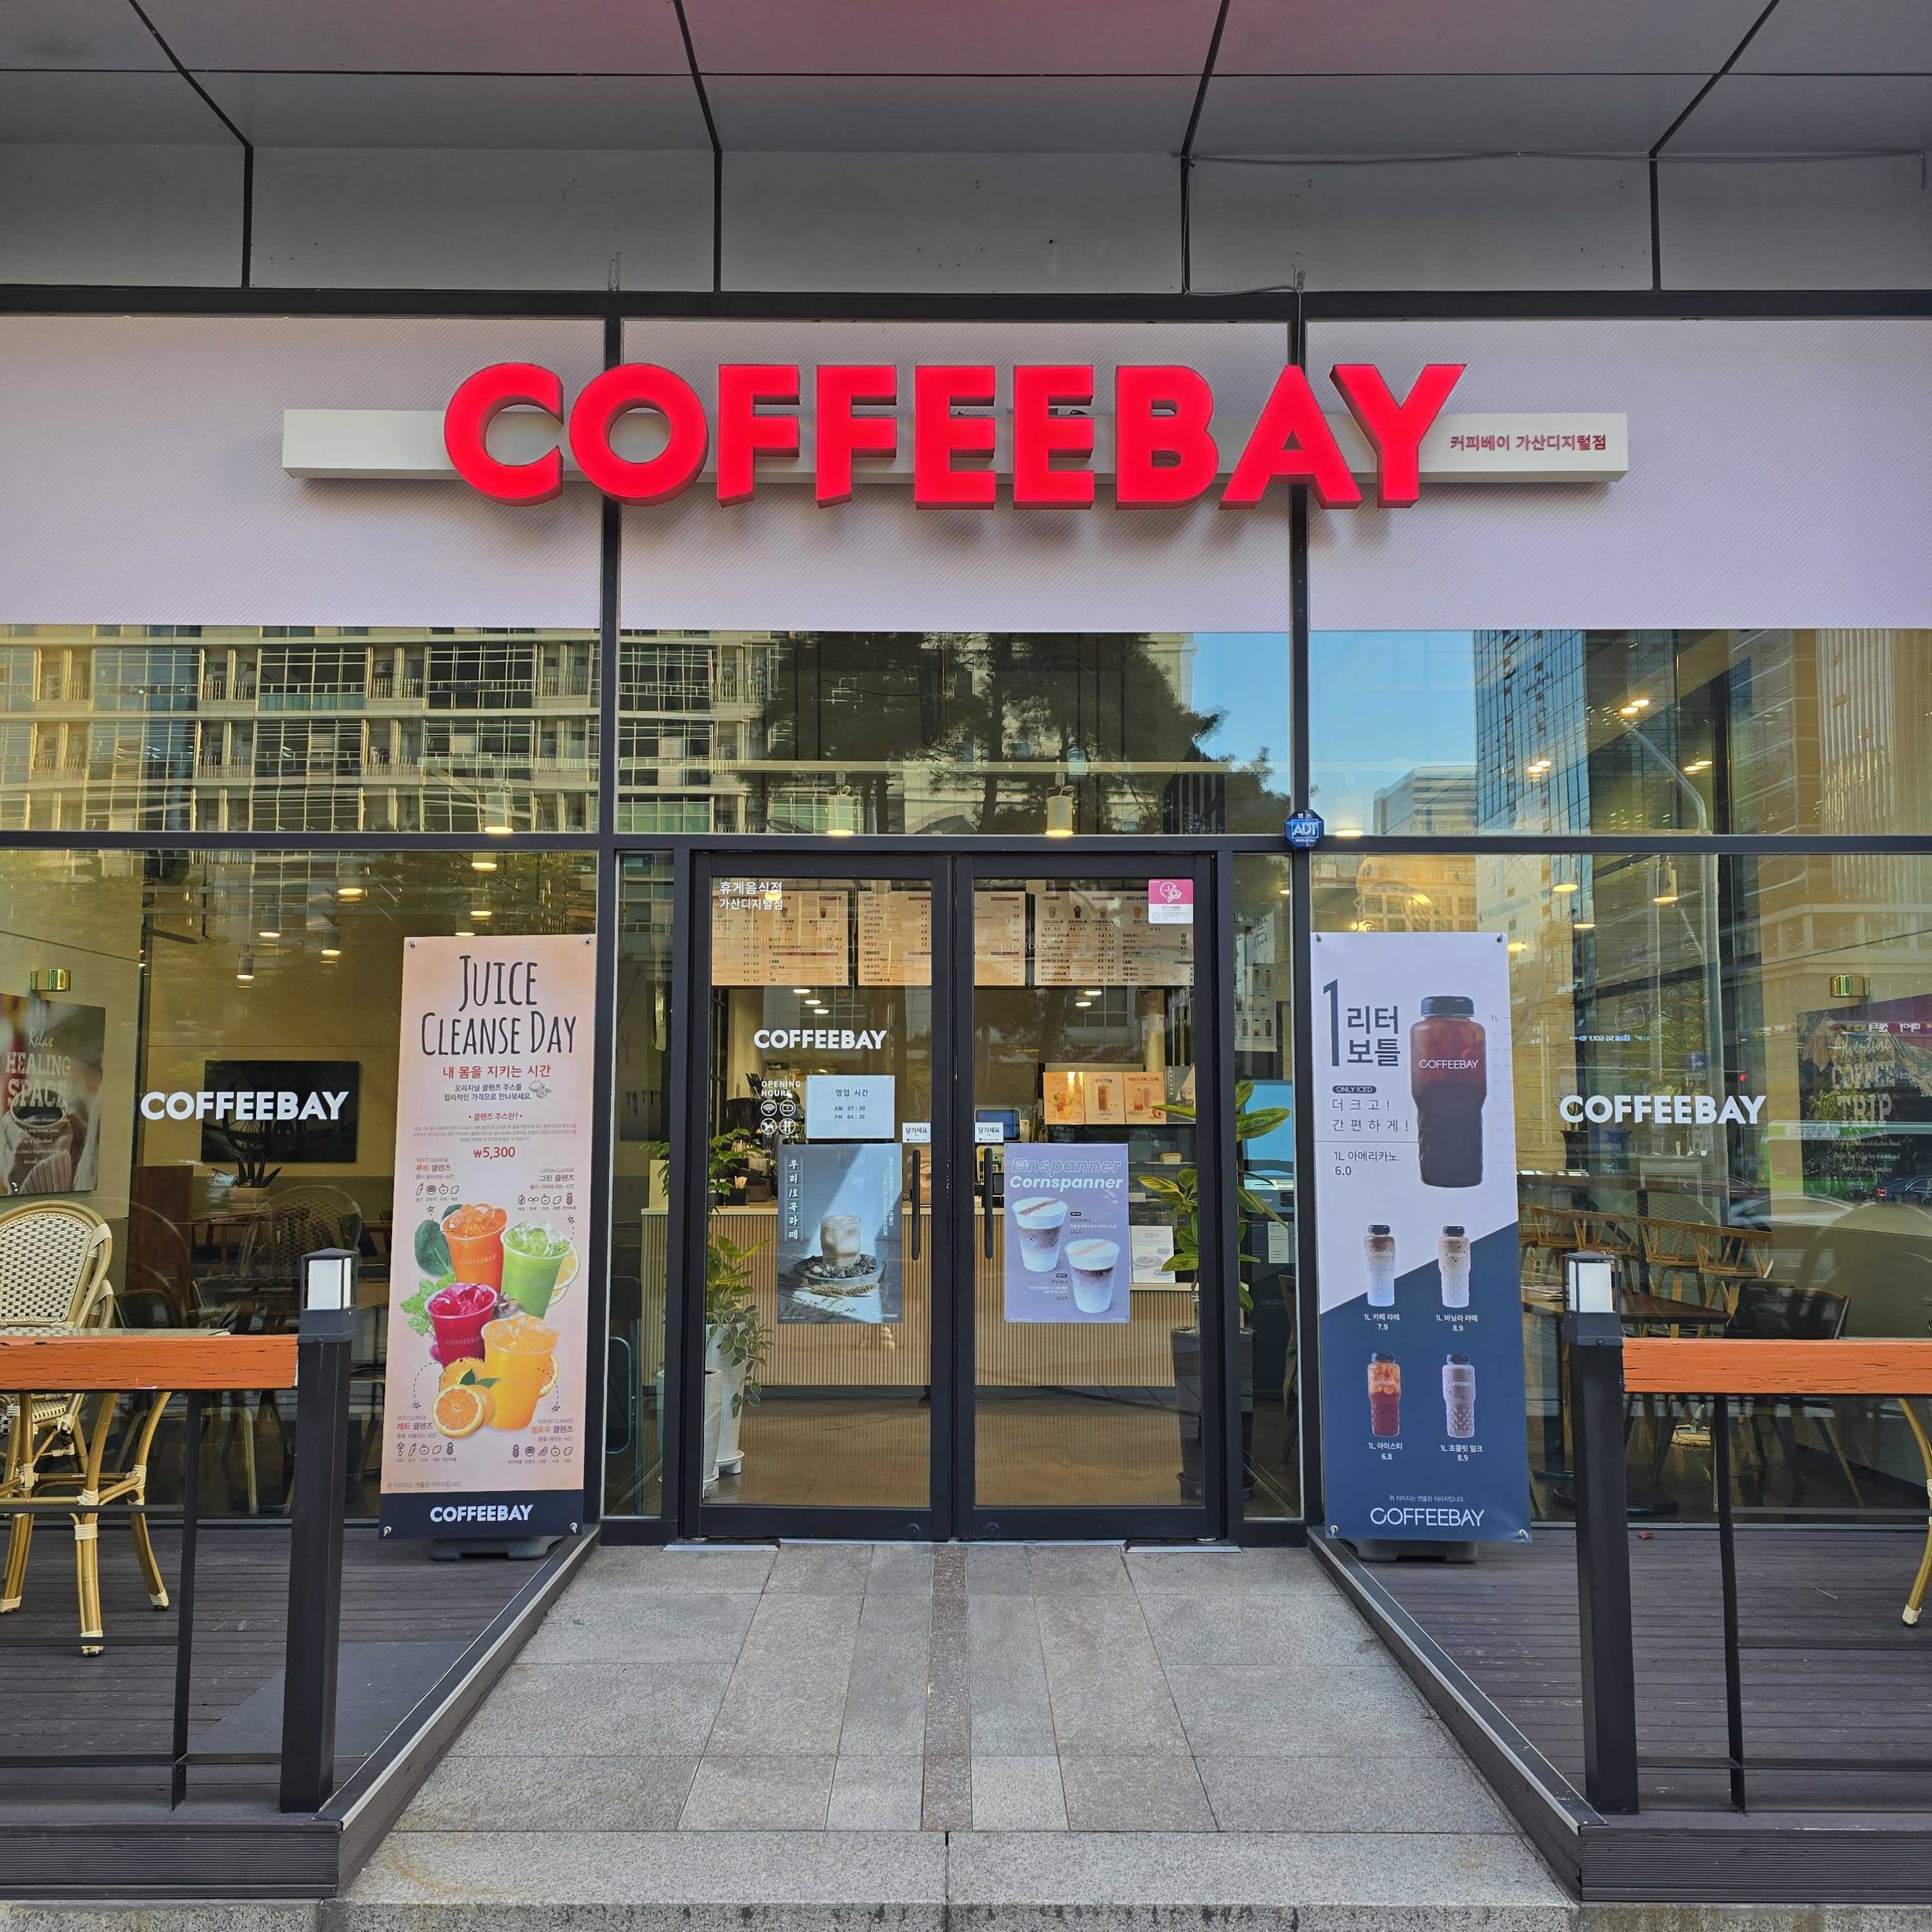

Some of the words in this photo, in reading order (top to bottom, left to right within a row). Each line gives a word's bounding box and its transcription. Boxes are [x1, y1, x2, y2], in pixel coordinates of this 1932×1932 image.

[444, 362, 1467, 509] COFFEEBAY
[1451, 435, 1510, 451] 커피베이
[1516, 435, 1606, 451] 가산디지털점
[1292, 822, 1317, 835] ADT
[458, 955, 538, 1012] JUICE
[1323, 979, 1339, 1066] 1
[1347, 1005, 1398, 1034] 리터
[422, 1012, 521, 1055] CLEANSE
[530, 1011, 577, 1053] DAY
[754, 1030, 887, 1049] COFFEEBAY
[1347, 1038, 1401, 1067] 보틀
[6, 1051, 71, 1076] HEALING
[443, 1067, 454, 1079] 내
[458, 1066, 482, 1078] 몸을
[487, 1065, 522, 1078] 지키는
[527, 1065, 551, 1078] 시간
[1419, 1059, 1479, 1069] COFFEEBAY
[7, 1078, 68, 1107] SPACE
[140, 1091, 349, 1120] COFFEEBAY
[1559, 1095, 1767, 1124] COFFEEBAY
[1837, 1093, 1893, 1127] TRIP
[473, 1147, 515, 1159] ₩5,300
[1334, 1152, 1344, 1161] 1L
[1348, 1151, 1398, 1162] 아메리카노
[1011, 1156, 1122, 1177] Einspanner
[1335, 1166, 1351, 1176] 6.0
[1010, 1176, 1124, 1192] Cornspanner
[430, 1504, 533, 1523] COFFEEBAY
[1370, 1507, 1485, 1526] COFFEEBAY
